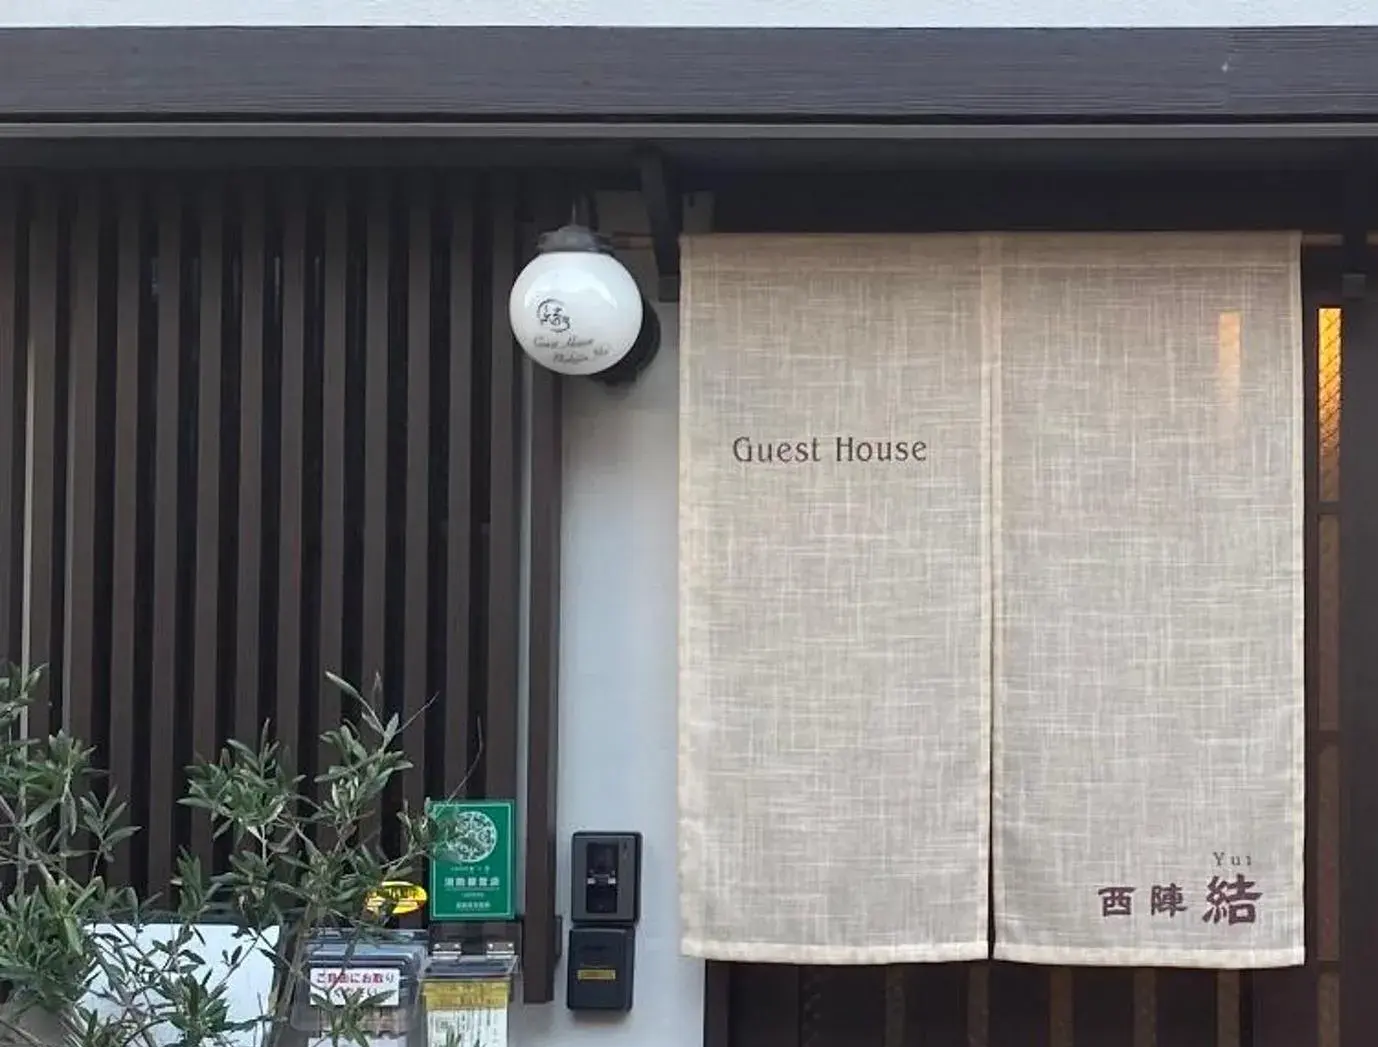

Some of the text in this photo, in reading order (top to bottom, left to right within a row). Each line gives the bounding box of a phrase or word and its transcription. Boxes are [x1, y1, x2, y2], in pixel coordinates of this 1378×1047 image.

[732, 436, 928, 463] Guest House
[1212, 851, 1253, 867] Yui
[1097, 872, 1264, 926] 西陣結
